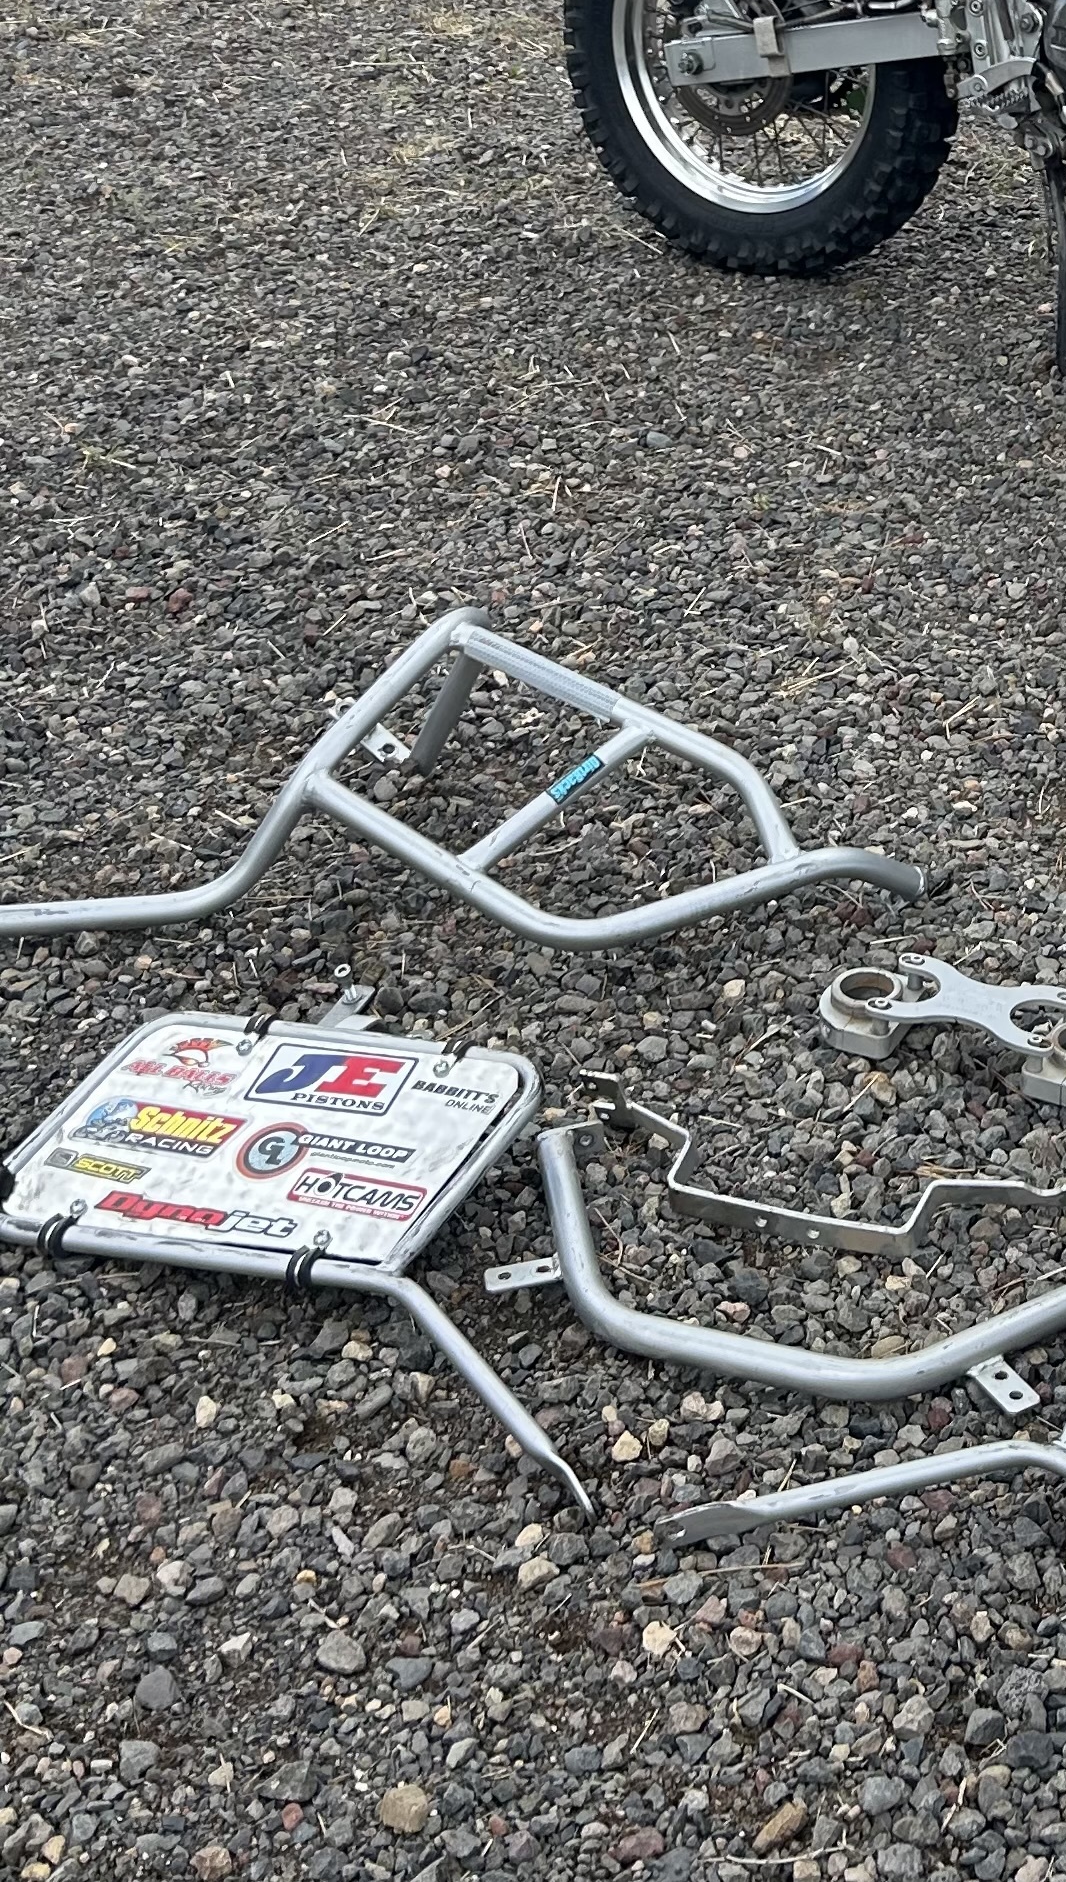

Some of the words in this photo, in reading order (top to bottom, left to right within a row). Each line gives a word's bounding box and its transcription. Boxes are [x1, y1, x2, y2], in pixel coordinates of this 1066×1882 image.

[254, 1053, 406, 1099] JE
[290, 1092, 387, 1111] PISTONS
[411, 1079, 500, 1104] BABBITT'S
[445, 1099, 494, 1115] ONLINE
[129, 1106, 239, 1144] Schnitz
[124, 1132, 216, 1155] RACING
[298, 1132, 356, 1153] GIANT
[358, 1142, 410, 1160] LOOP
[73, 1155, 142, 1183] SCOTT
[296, 1173, 420, 1211] HOTCAMS
